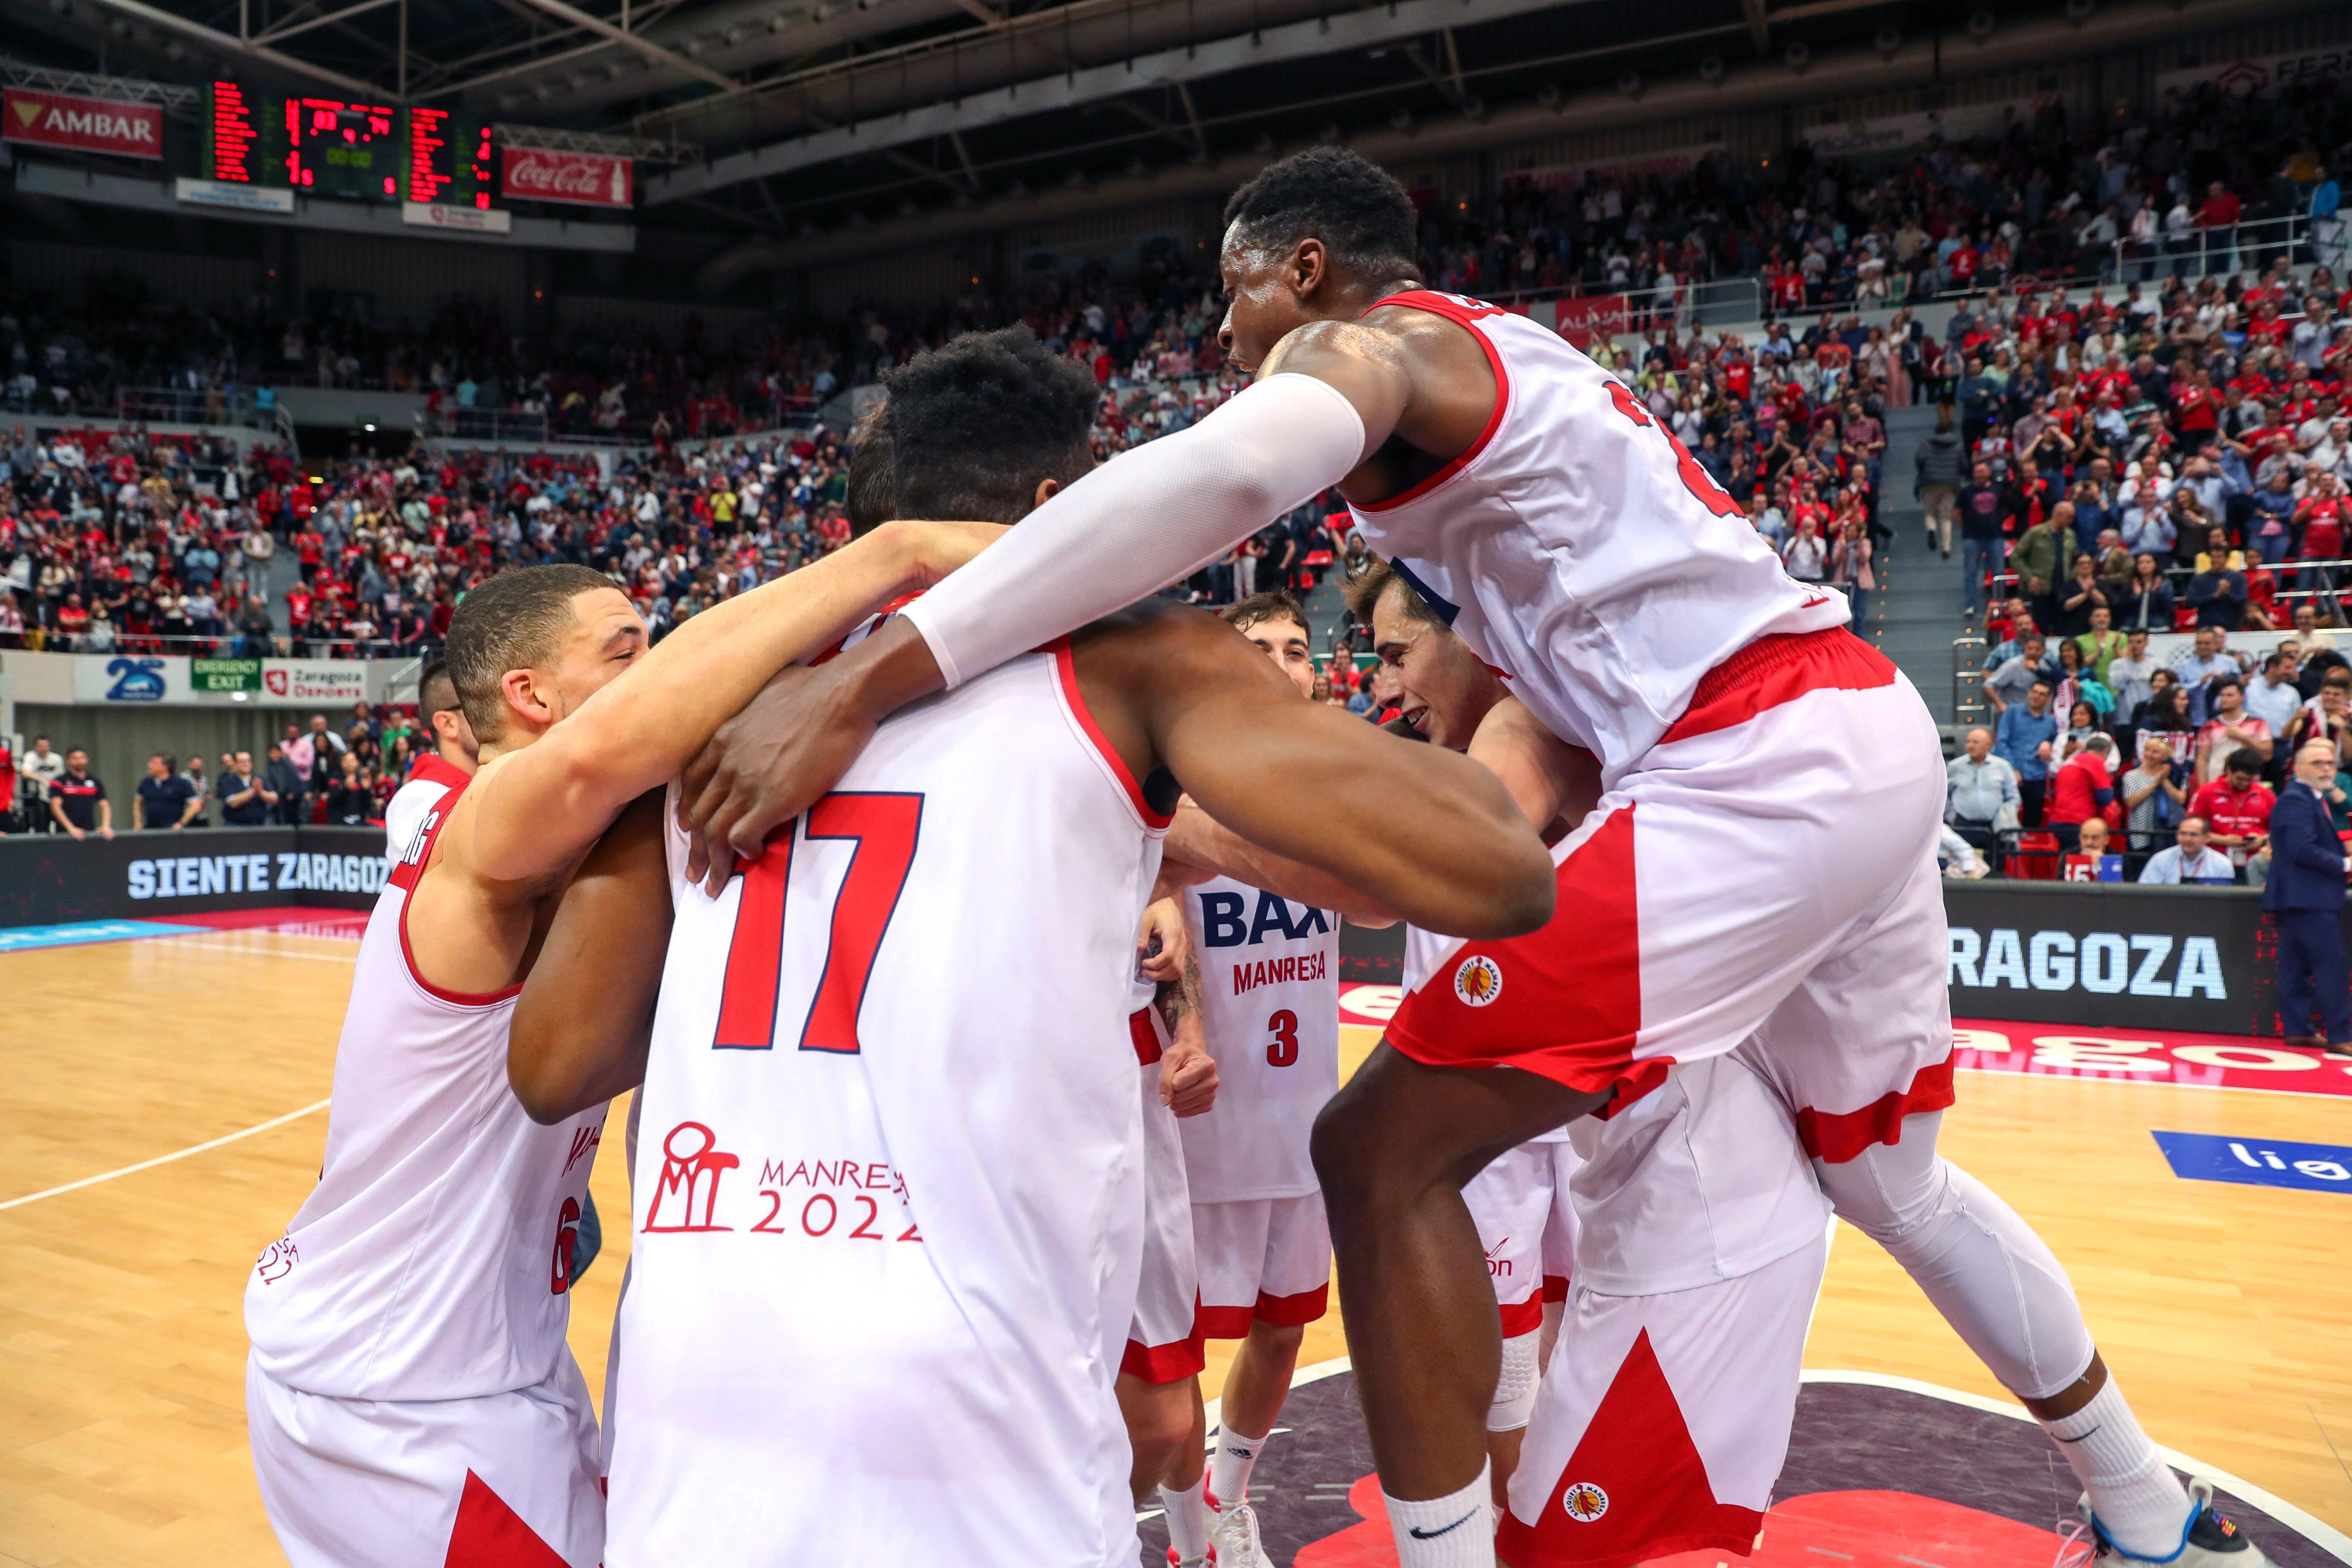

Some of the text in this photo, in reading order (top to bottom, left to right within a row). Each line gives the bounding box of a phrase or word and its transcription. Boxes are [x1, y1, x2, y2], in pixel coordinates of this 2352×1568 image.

[44, 107, 154, 144] AMBAR
[106, 658, 165, 700] 25
[194, 659, 257, 674] EMERGENCY
[208, 675, 244, 689] EXIT
[294, 669, 362, 685] Zaragoza
[128, 854, 270, 900] SIENTE
[711, 792, 925, 1054] 17
[1233, 950, 1325, 996] MANRESA
[1266, 1009, 1298, 1067] 3
[551, 1196, 580, 1295] 6
